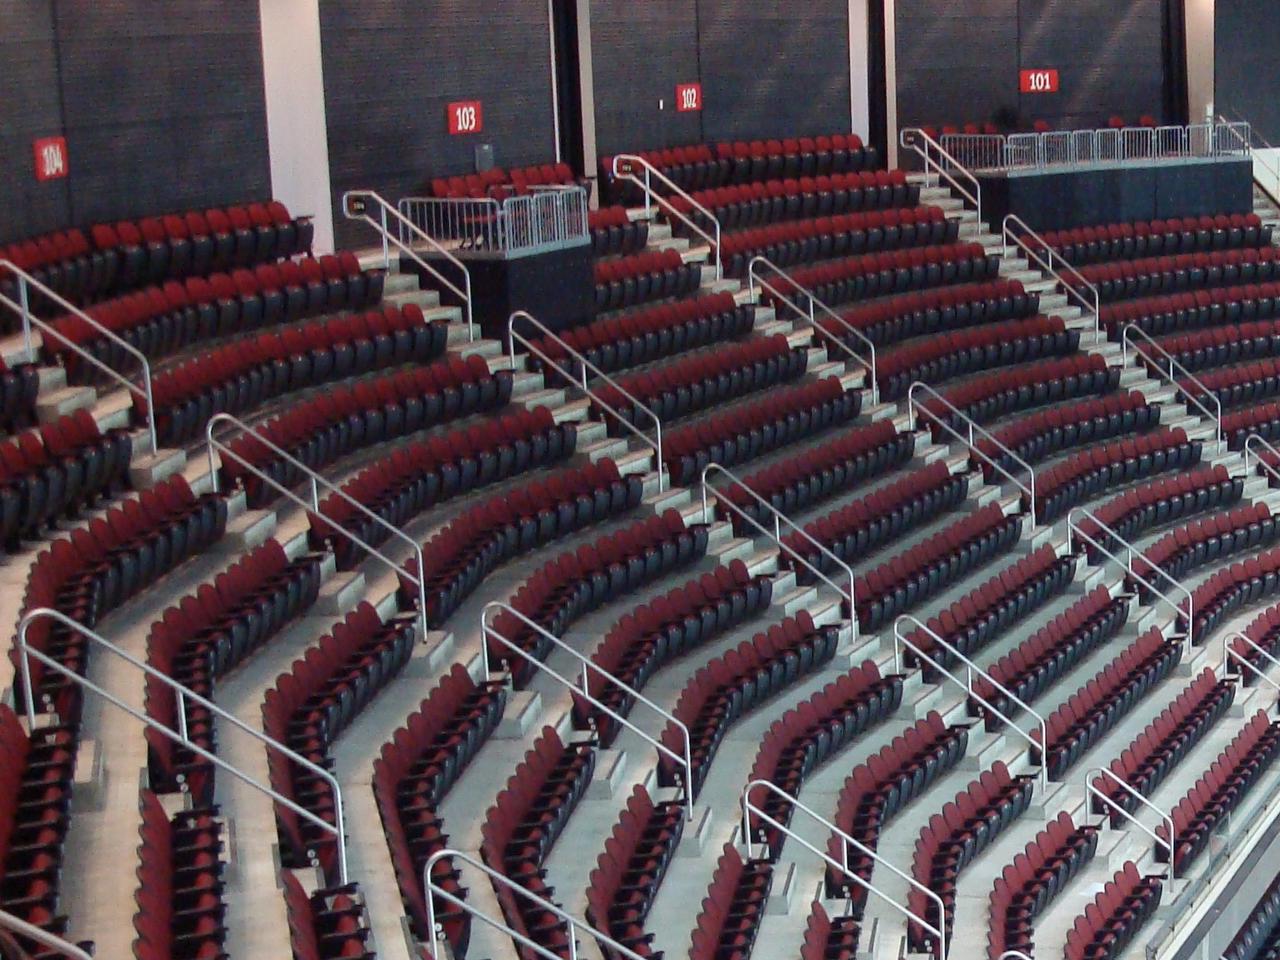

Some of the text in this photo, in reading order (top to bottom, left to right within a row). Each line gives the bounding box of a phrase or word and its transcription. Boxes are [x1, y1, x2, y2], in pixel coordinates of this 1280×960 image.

[1030, 72, 1051, 90] 101
[682, 88, 697, 109] 102
[456, 106, 476, 131] 103
